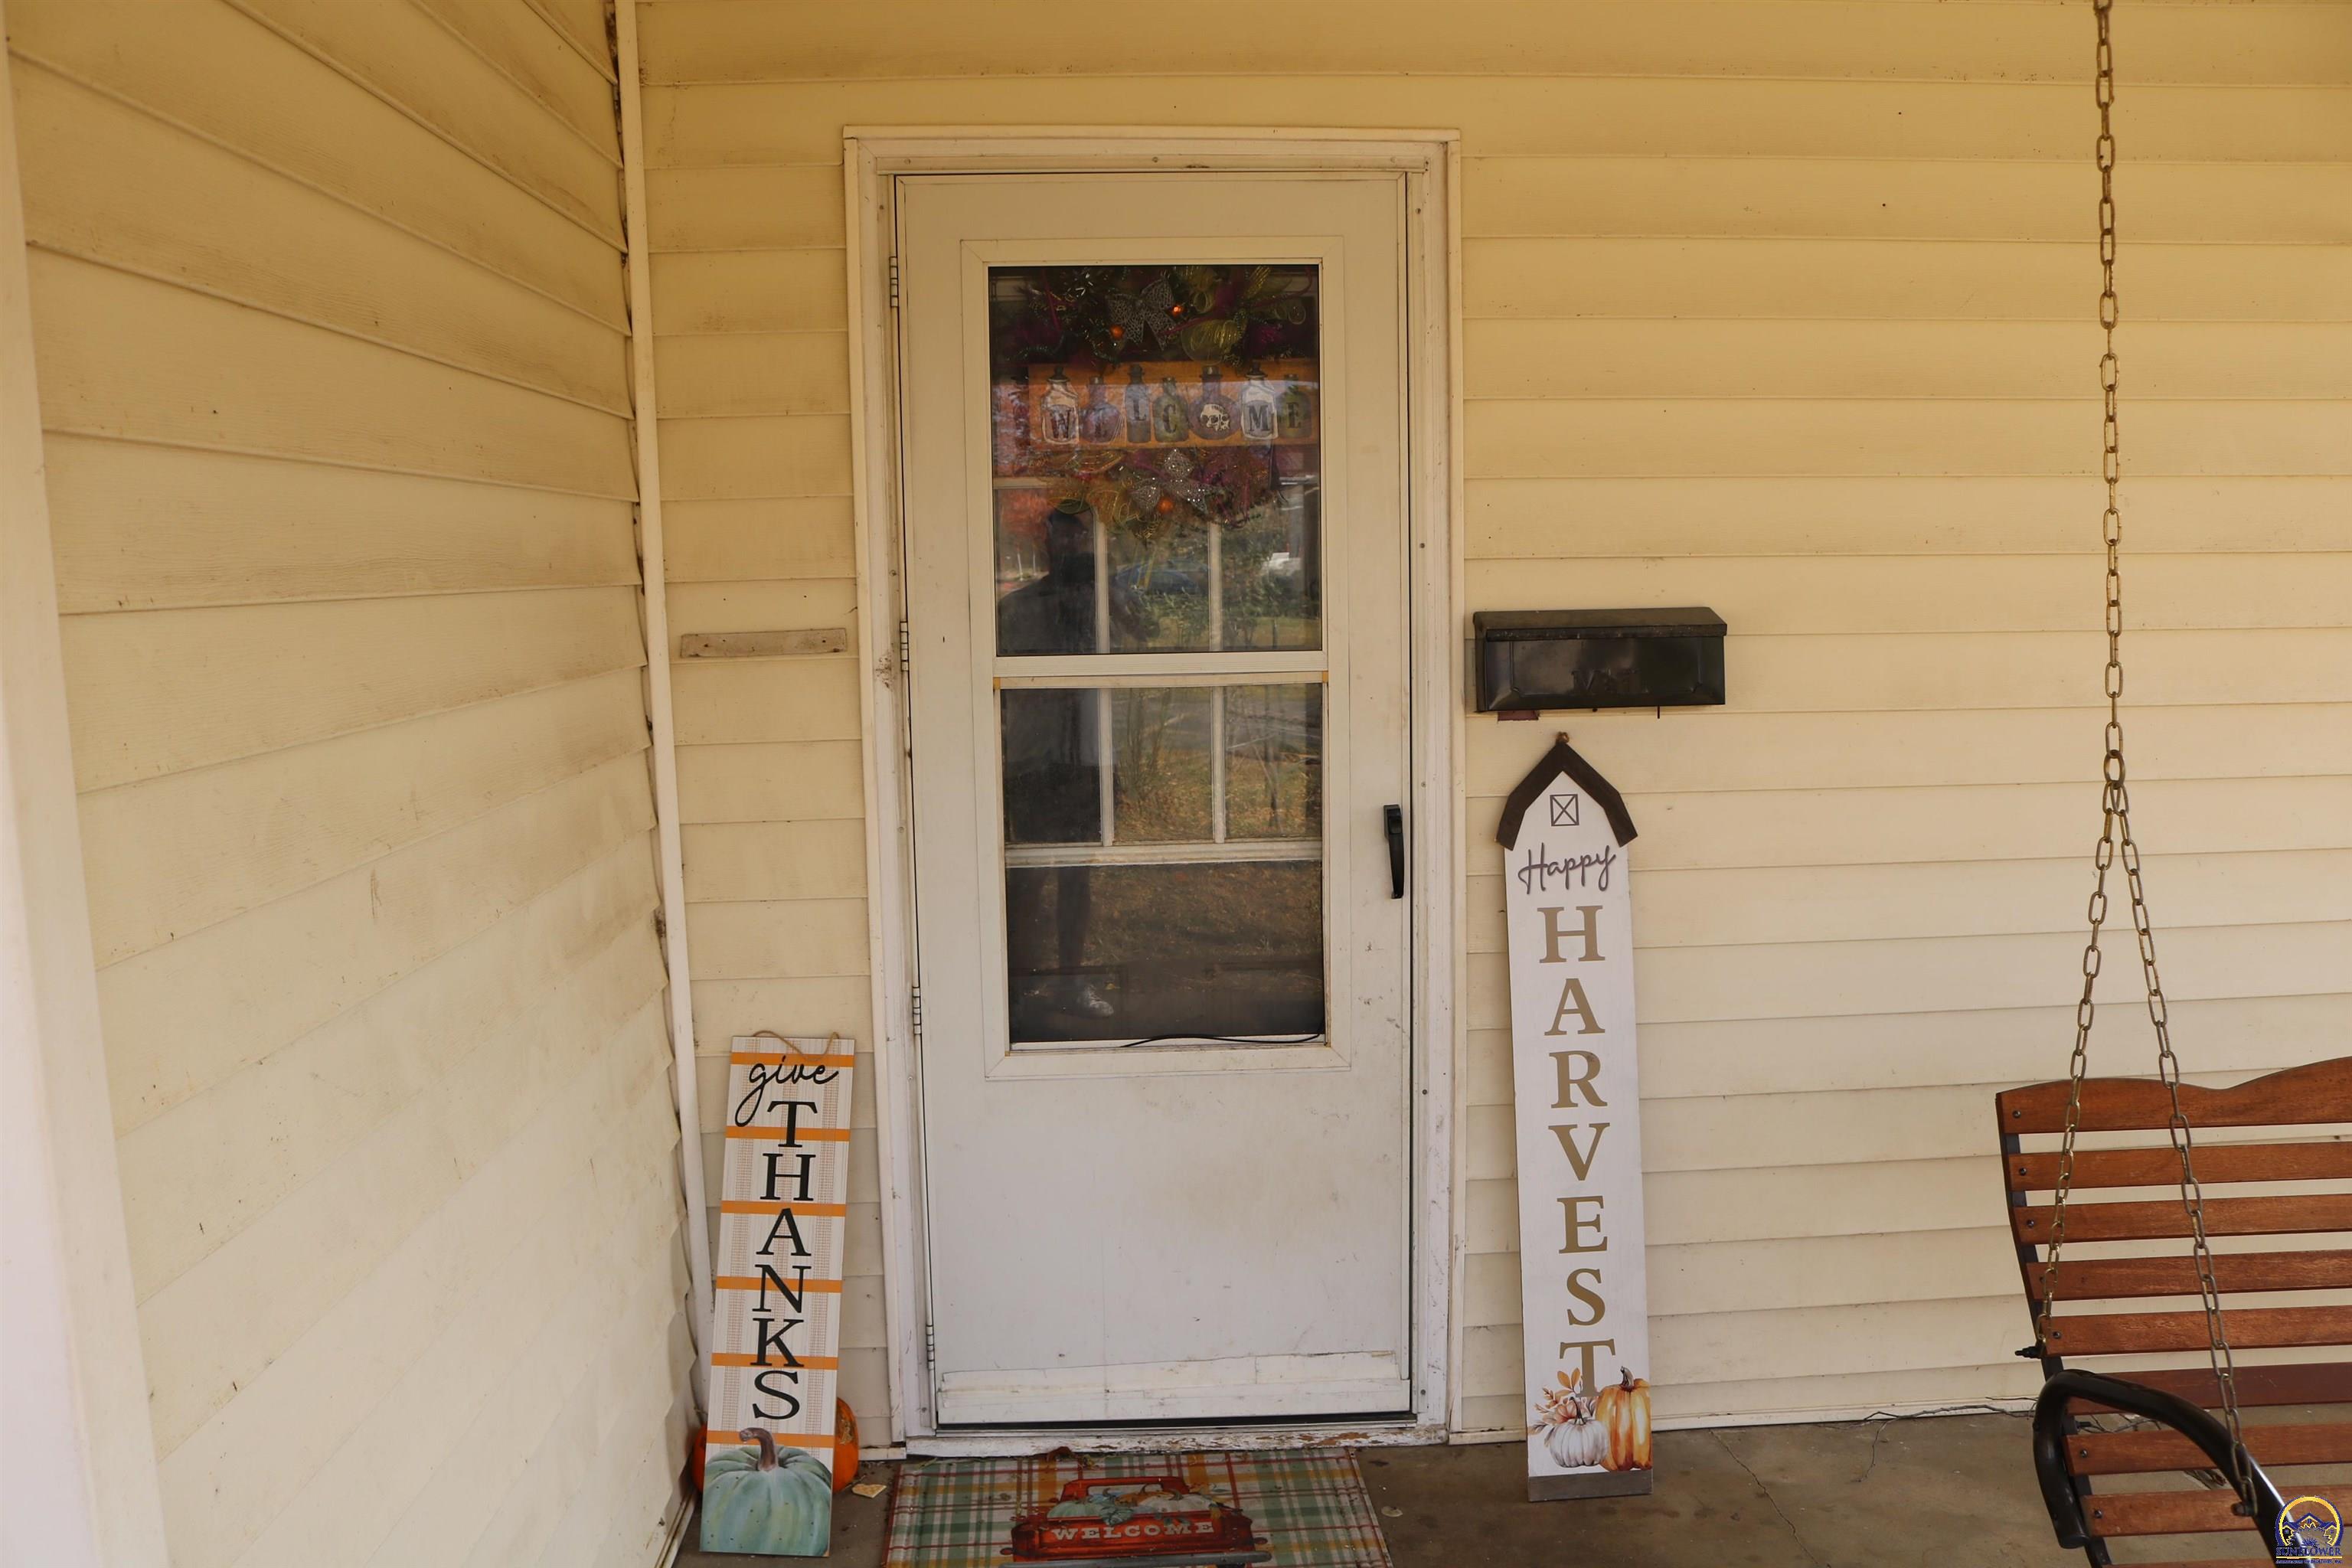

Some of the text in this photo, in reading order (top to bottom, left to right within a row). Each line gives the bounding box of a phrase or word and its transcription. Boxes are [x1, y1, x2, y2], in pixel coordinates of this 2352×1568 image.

[1517, 842, 1616, 894] Happy
[734, 1055, 838, 1126] give
[1537, 905, 1615, 1397] HARVEST
[750, 1100, 818, 1420] THANKS
[1052, 1521, 1214, 1540] WELCOME
